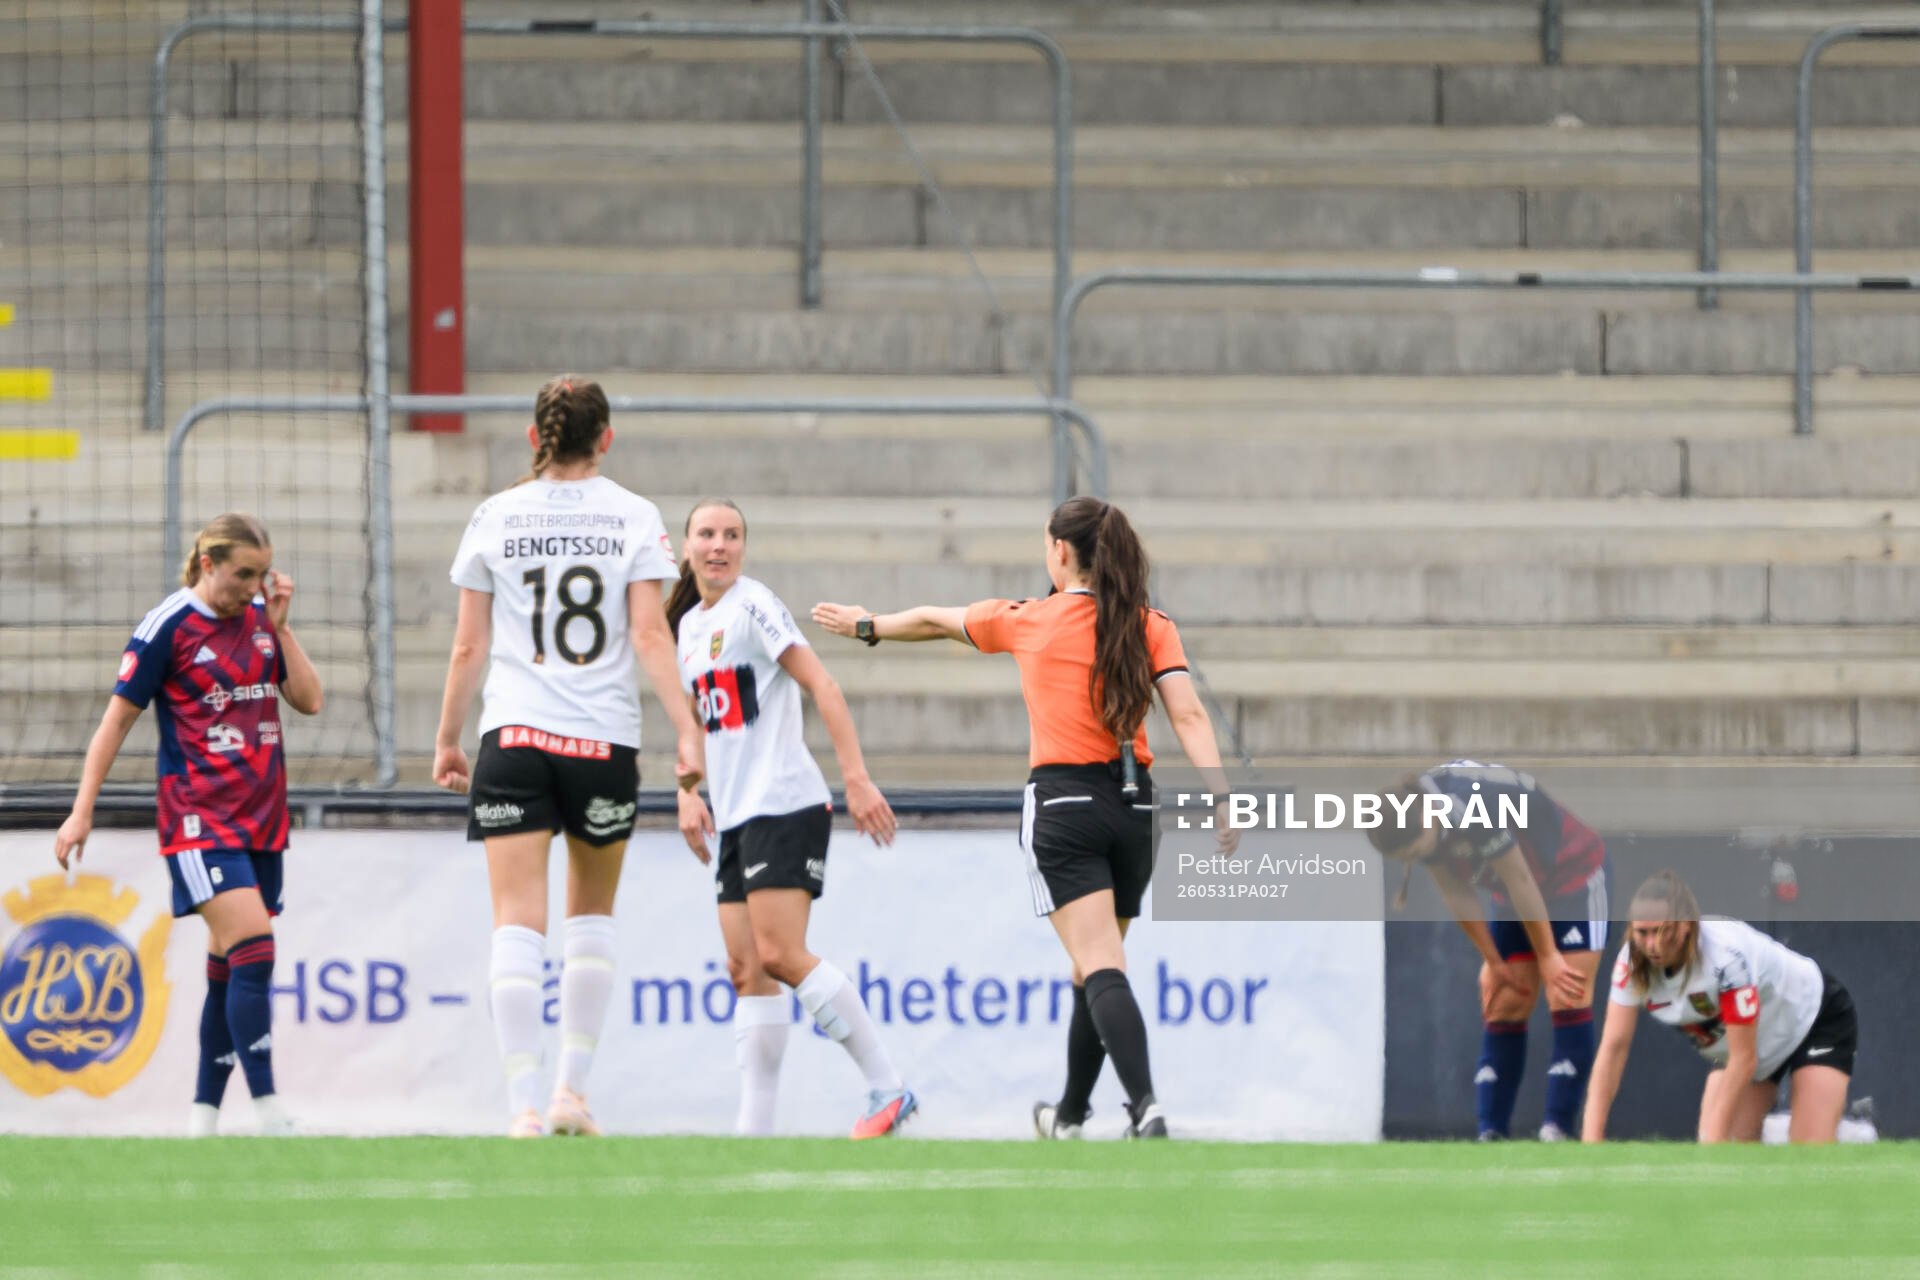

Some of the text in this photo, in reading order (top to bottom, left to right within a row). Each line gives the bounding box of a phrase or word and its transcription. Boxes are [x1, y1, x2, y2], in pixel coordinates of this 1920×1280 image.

[504, 513, 627, 532] HOLSTEBROGRUPPEN
[503, 537, 625, 559] BENGTSSON
[522, 565, 607, 665] 18
[501, 727, 612, 758] BAUHAUS
[1156, 959, 1268, 1025] bor
[1734, 988, 1757, 1018] C
